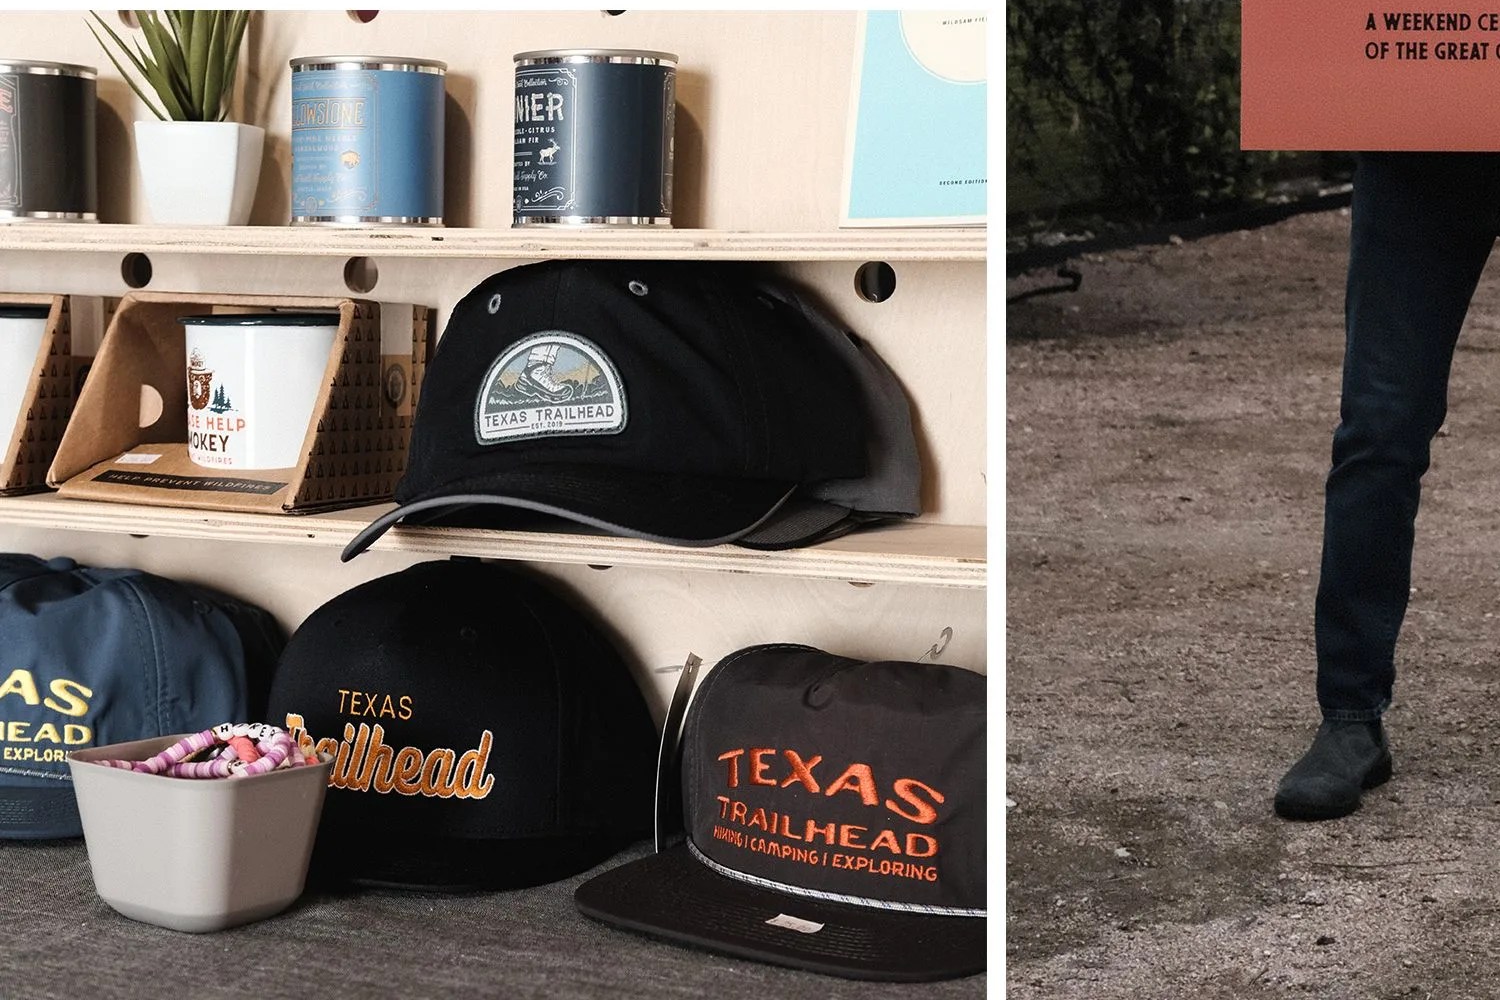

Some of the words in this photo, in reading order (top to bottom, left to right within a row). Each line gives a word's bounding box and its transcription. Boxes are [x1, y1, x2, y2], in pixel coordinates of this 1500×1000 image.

[1365, 12, 1377, 31] A
[1384, 13, 1472, 32] WEEKEND
[1364, 41, 1390, 60] OF
[1395, 41, 1429, 60] THE
[1434, 41, 1490, 61] GREAT
[206, 417, 245, 431] HELP
[485, 411, 527, 428] TEXAS
[536, 405, 614, 422] TRAILHEAD
[531, 422, 546, 430] EST.
[108, 473, 141, 482] HELP
[143, 475, 200, 486] PREVENT
[202, 478, 272, 491] WILDFIRES
[0, 669, 93, 717] AS
[338, 689, 414, 720] TEXAS
[717, 747, 945, 825] TEXAS
[716, 795, 938, 858] TRAILHEAD
[713, 825, 743, 849] HIKING
[750, 837, 819, 865] CAMPING
[832, 854, 938, 882] EXPLORING
